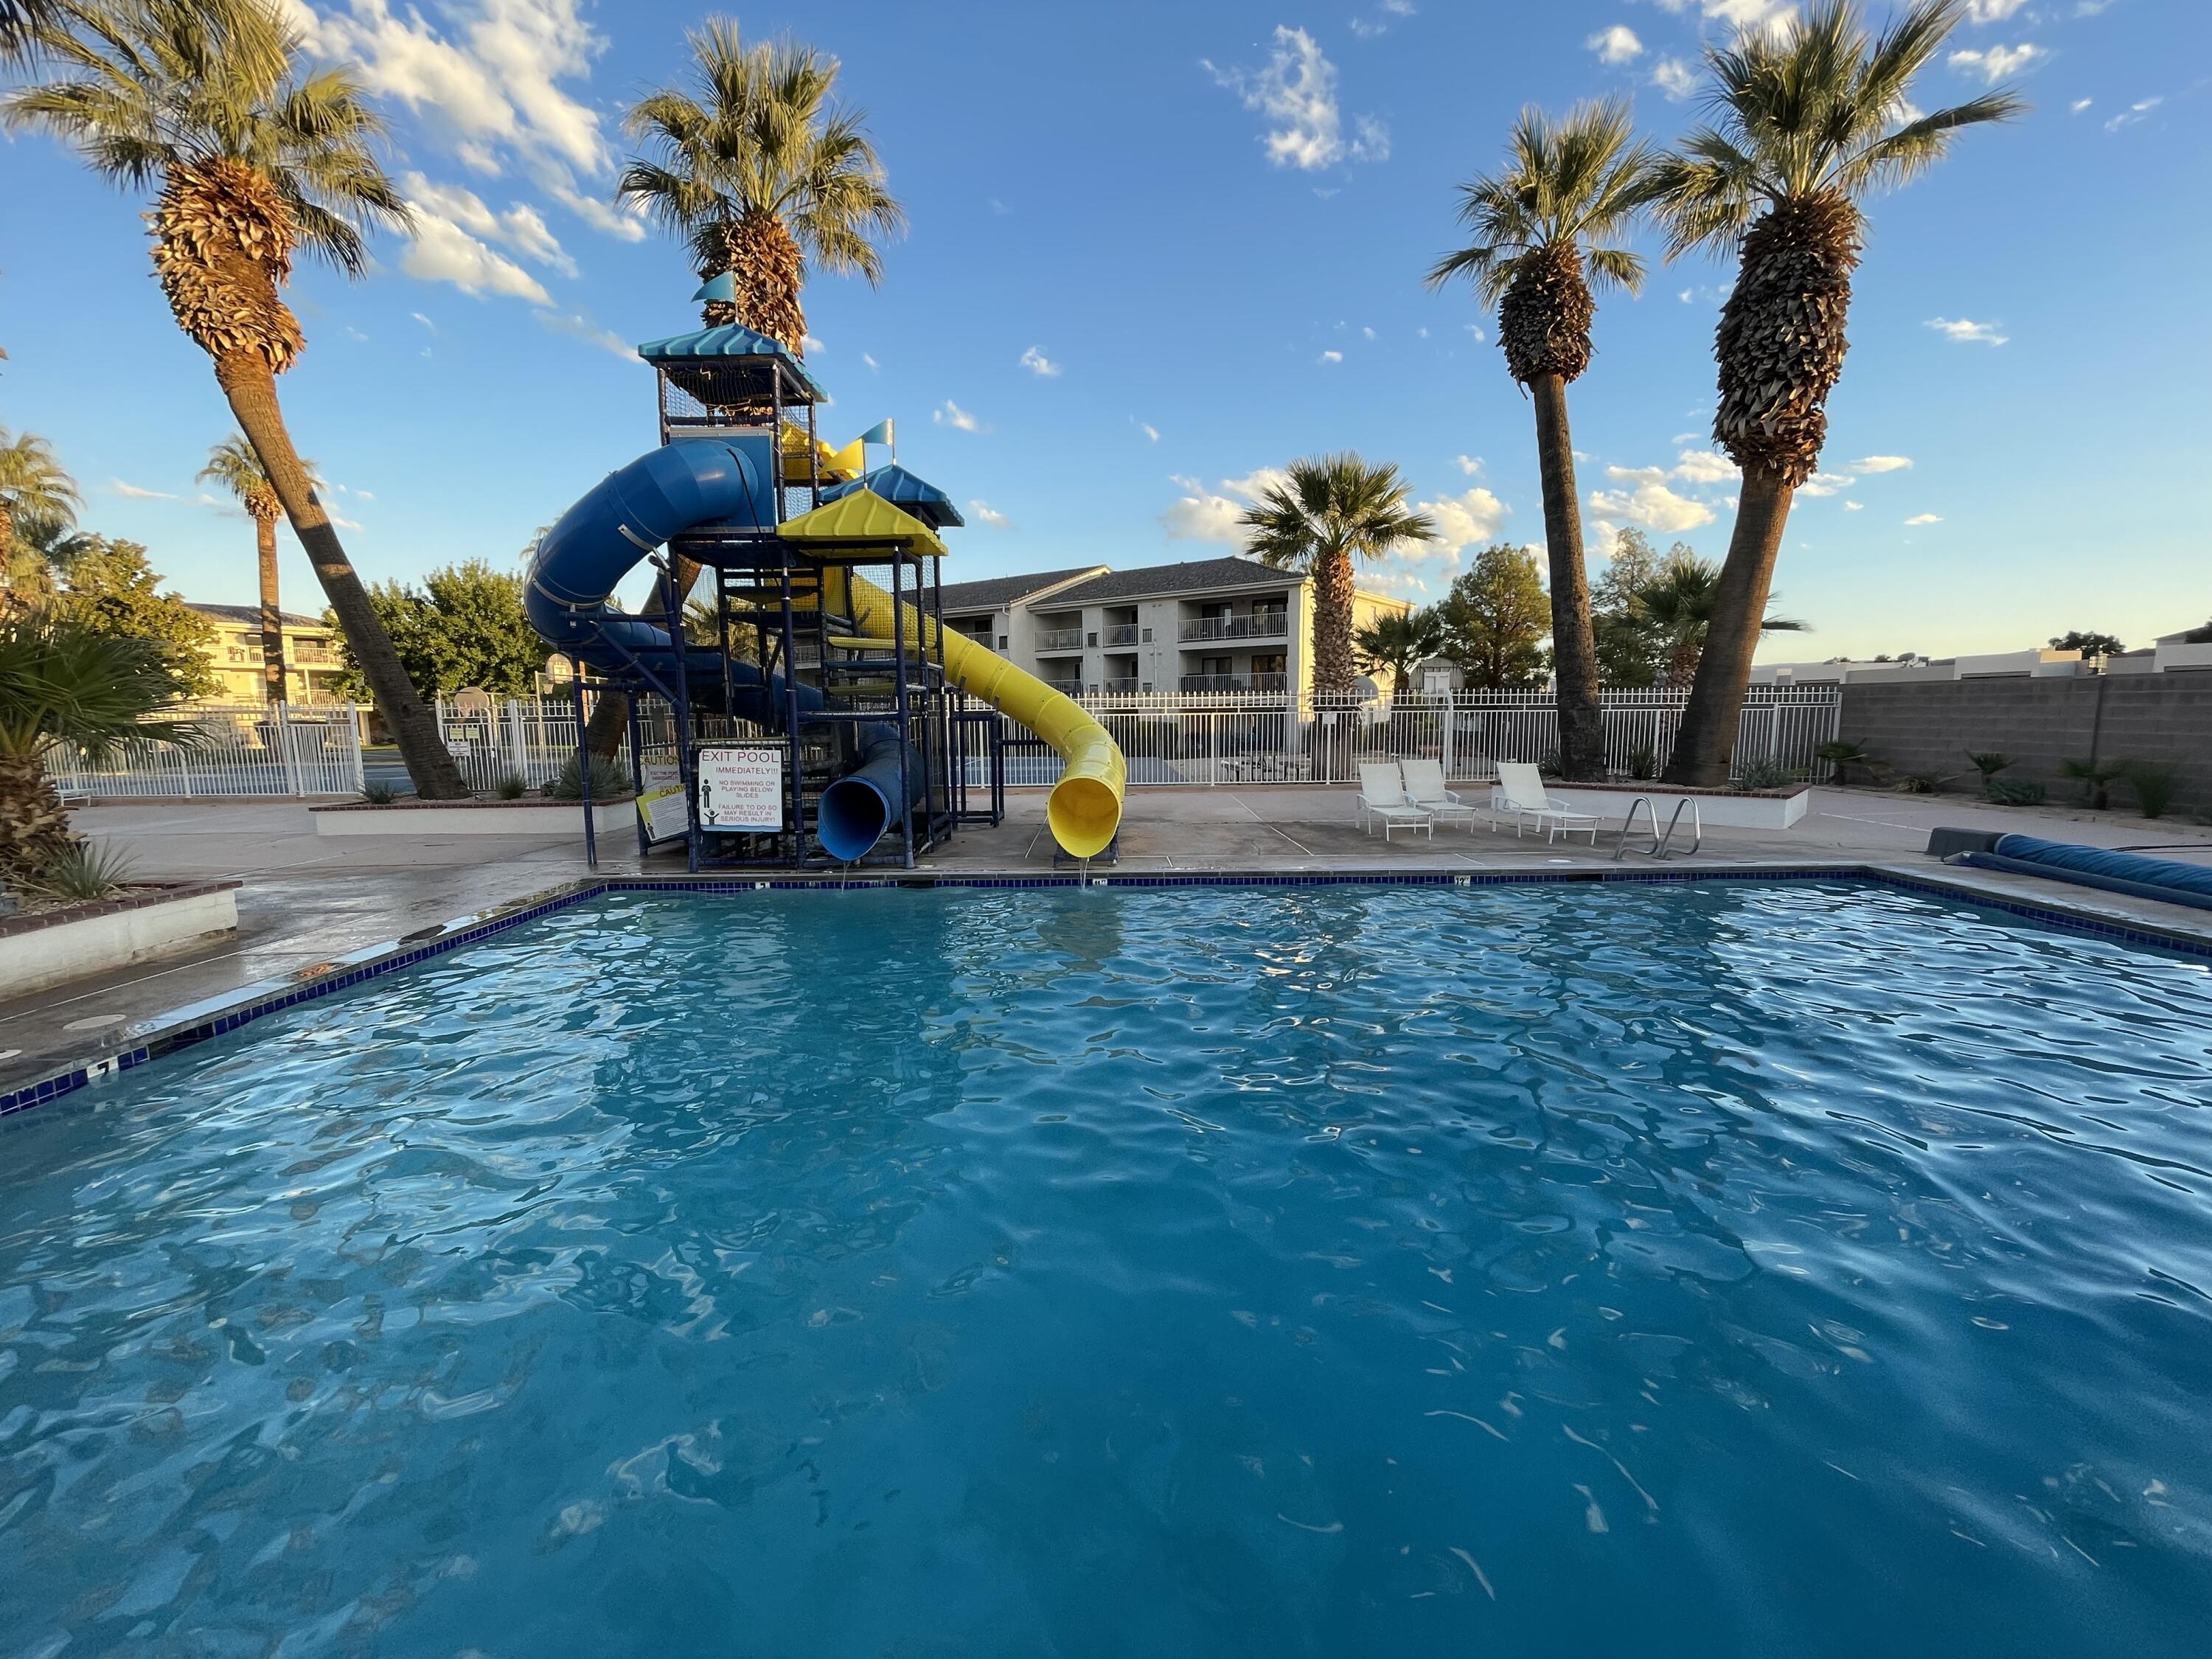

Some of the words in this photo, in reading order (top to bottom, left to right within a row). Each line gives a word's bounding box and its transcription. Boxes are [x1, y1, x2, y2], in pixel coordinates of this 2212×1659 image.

[702, 751, 732, 762] EXIT
[737, 751, 779, 763] POOL
[659, 783, 686, 797] CAUTI
[97, 1061, 109, 1075] 7
